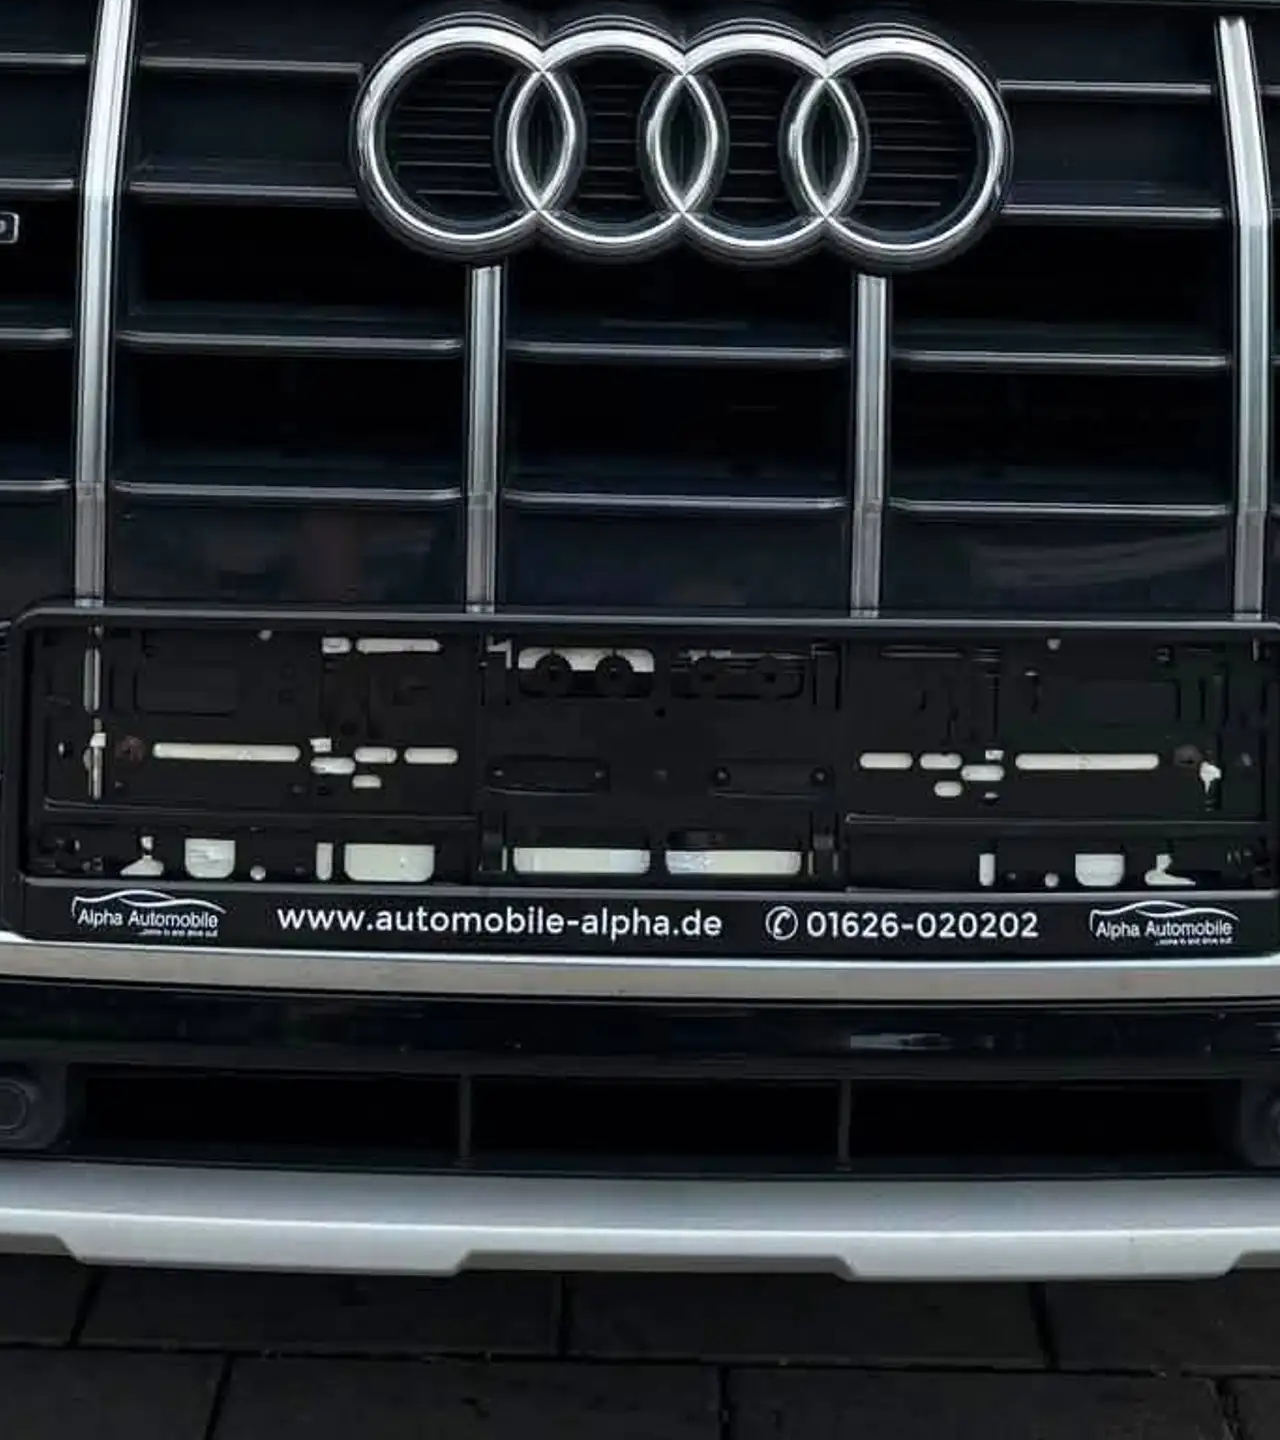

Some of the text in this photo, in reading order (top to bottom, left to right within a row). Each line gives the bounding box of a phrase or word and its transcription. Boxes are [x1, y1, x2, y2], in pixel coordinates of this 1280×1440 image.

[77, 908, 218, 928] Alpha Automobile
[277, 906, 1039, 943] www.automobile-alpha.de 01626-020202
[1095, 920, 1233, 940] Alpha Automobile
